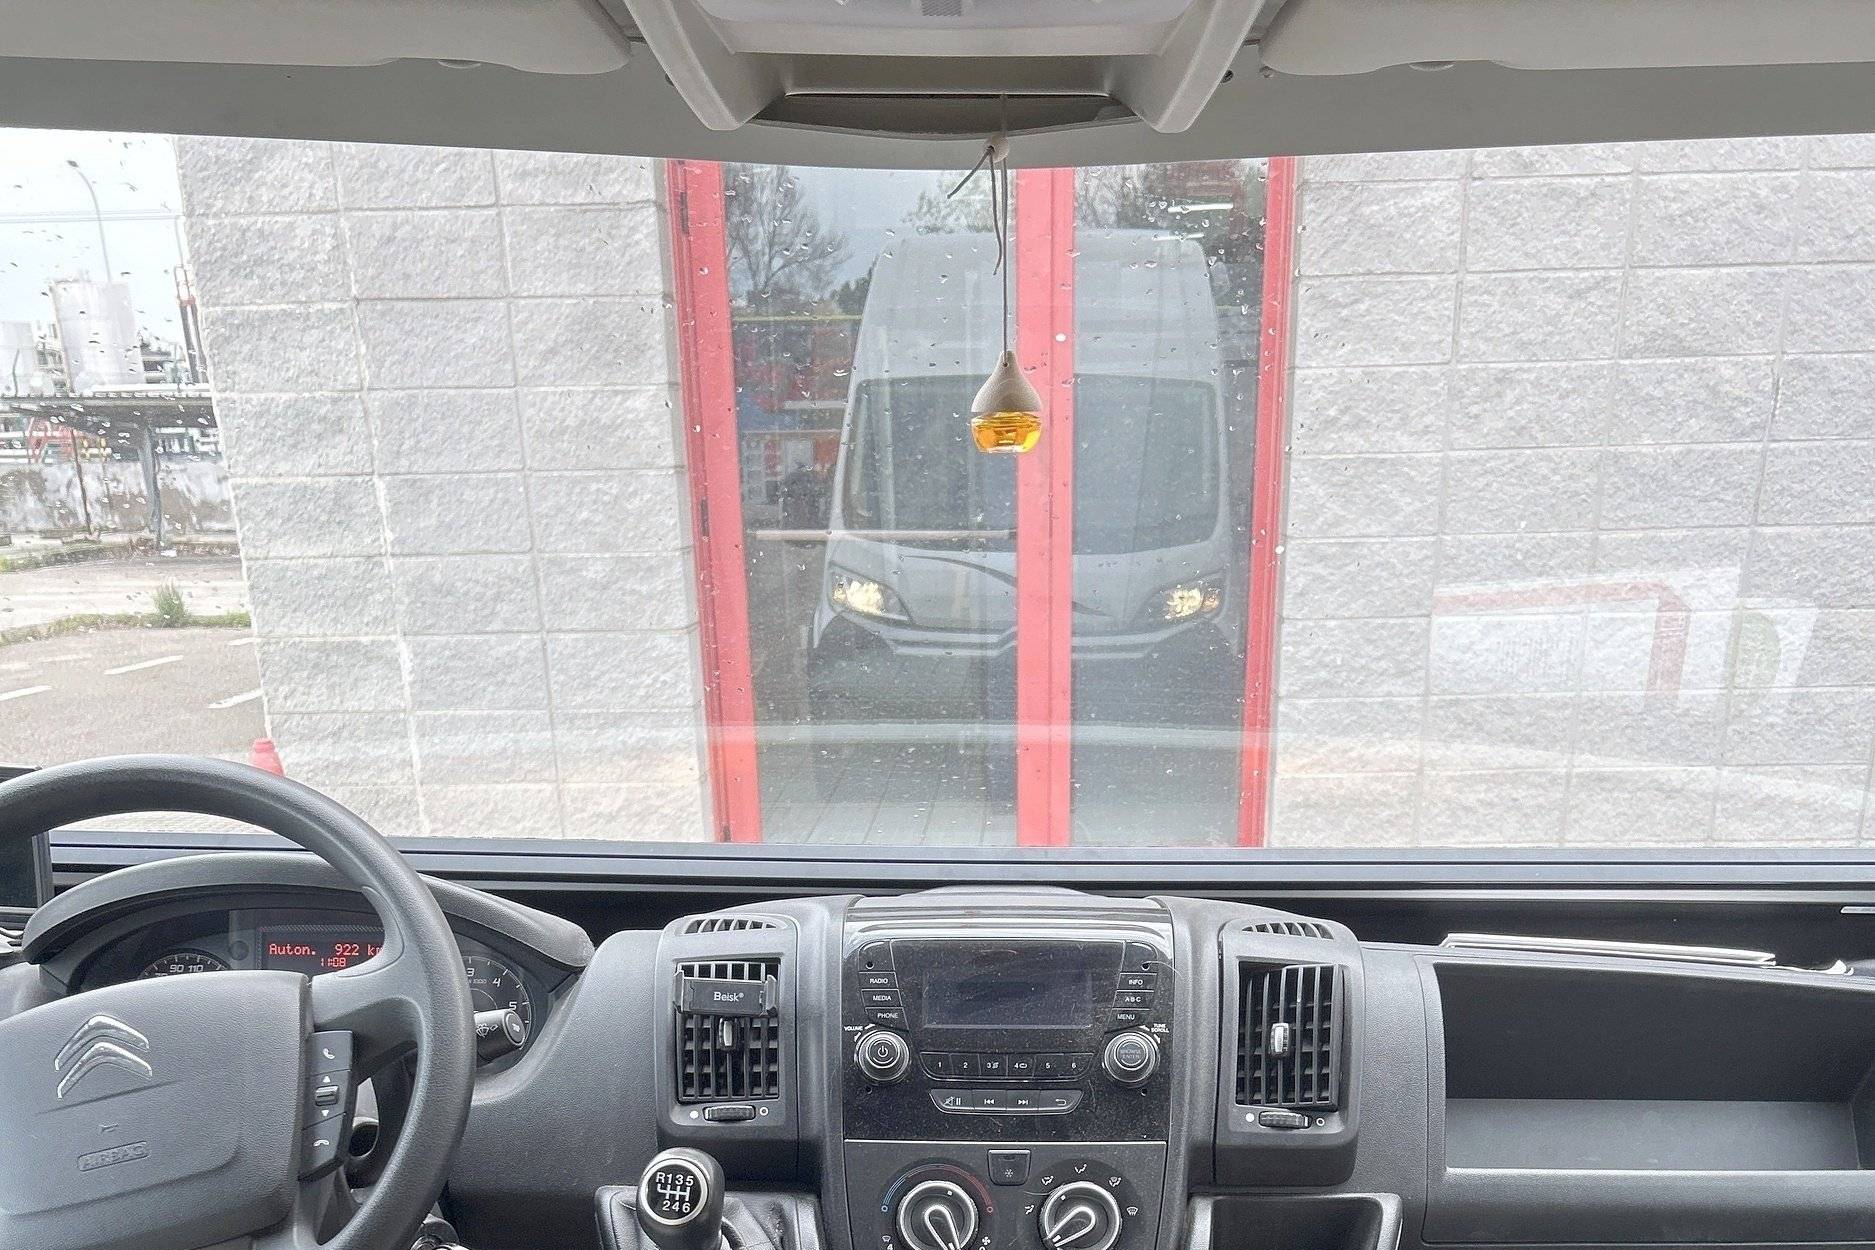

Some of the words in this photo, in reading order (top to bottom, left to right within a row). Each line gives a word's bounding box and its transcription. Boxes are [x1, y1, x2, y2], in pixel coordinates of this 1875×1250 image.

[269, 943, 316, 956] Auton.
[334, 943, 360, 956] 922
[320, 957, 347, 967] 11:08
[169, 964, 184, 973] 90
[188, 964, 204, 973] 110
[466, 967, 475, 977] 3
[492, 977, 501, 987] 4
[508, 1001, 518, 1010] 5
[655, 1171, 666, 1183] R
[666, 1173, 673, 1184] 1
[675, 1174, 684, 1185] 3
[685, 1175, 694, 1186] 5
[662, 1200, 670, 1211] 2
[671, 1201, 680, 1212] 4
[682, 1202, 691, 1213] 6
